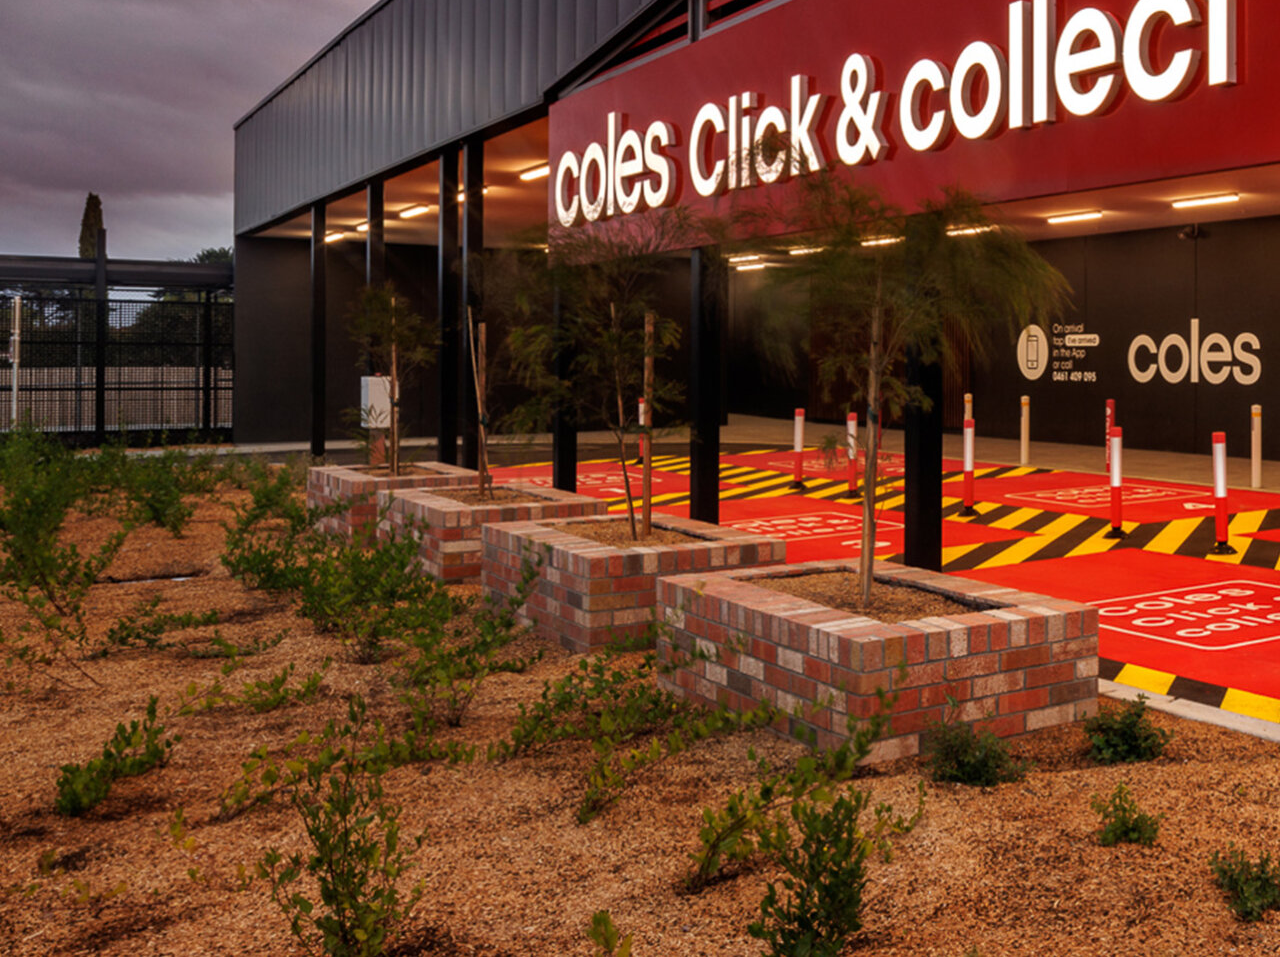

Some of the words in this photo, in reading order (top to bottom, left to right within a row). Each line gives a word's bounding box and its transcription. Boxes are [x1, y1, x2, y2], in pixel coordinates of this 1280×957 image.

[554, 111, 676, 227] coles
[688, 74, 823, 198] Click
[835, 53, 888, 166] &
[1127, 317, 1262, 385] coles
[1098, 587, 1255, 617] coles
[1131, 601, 1273, 627] Click
